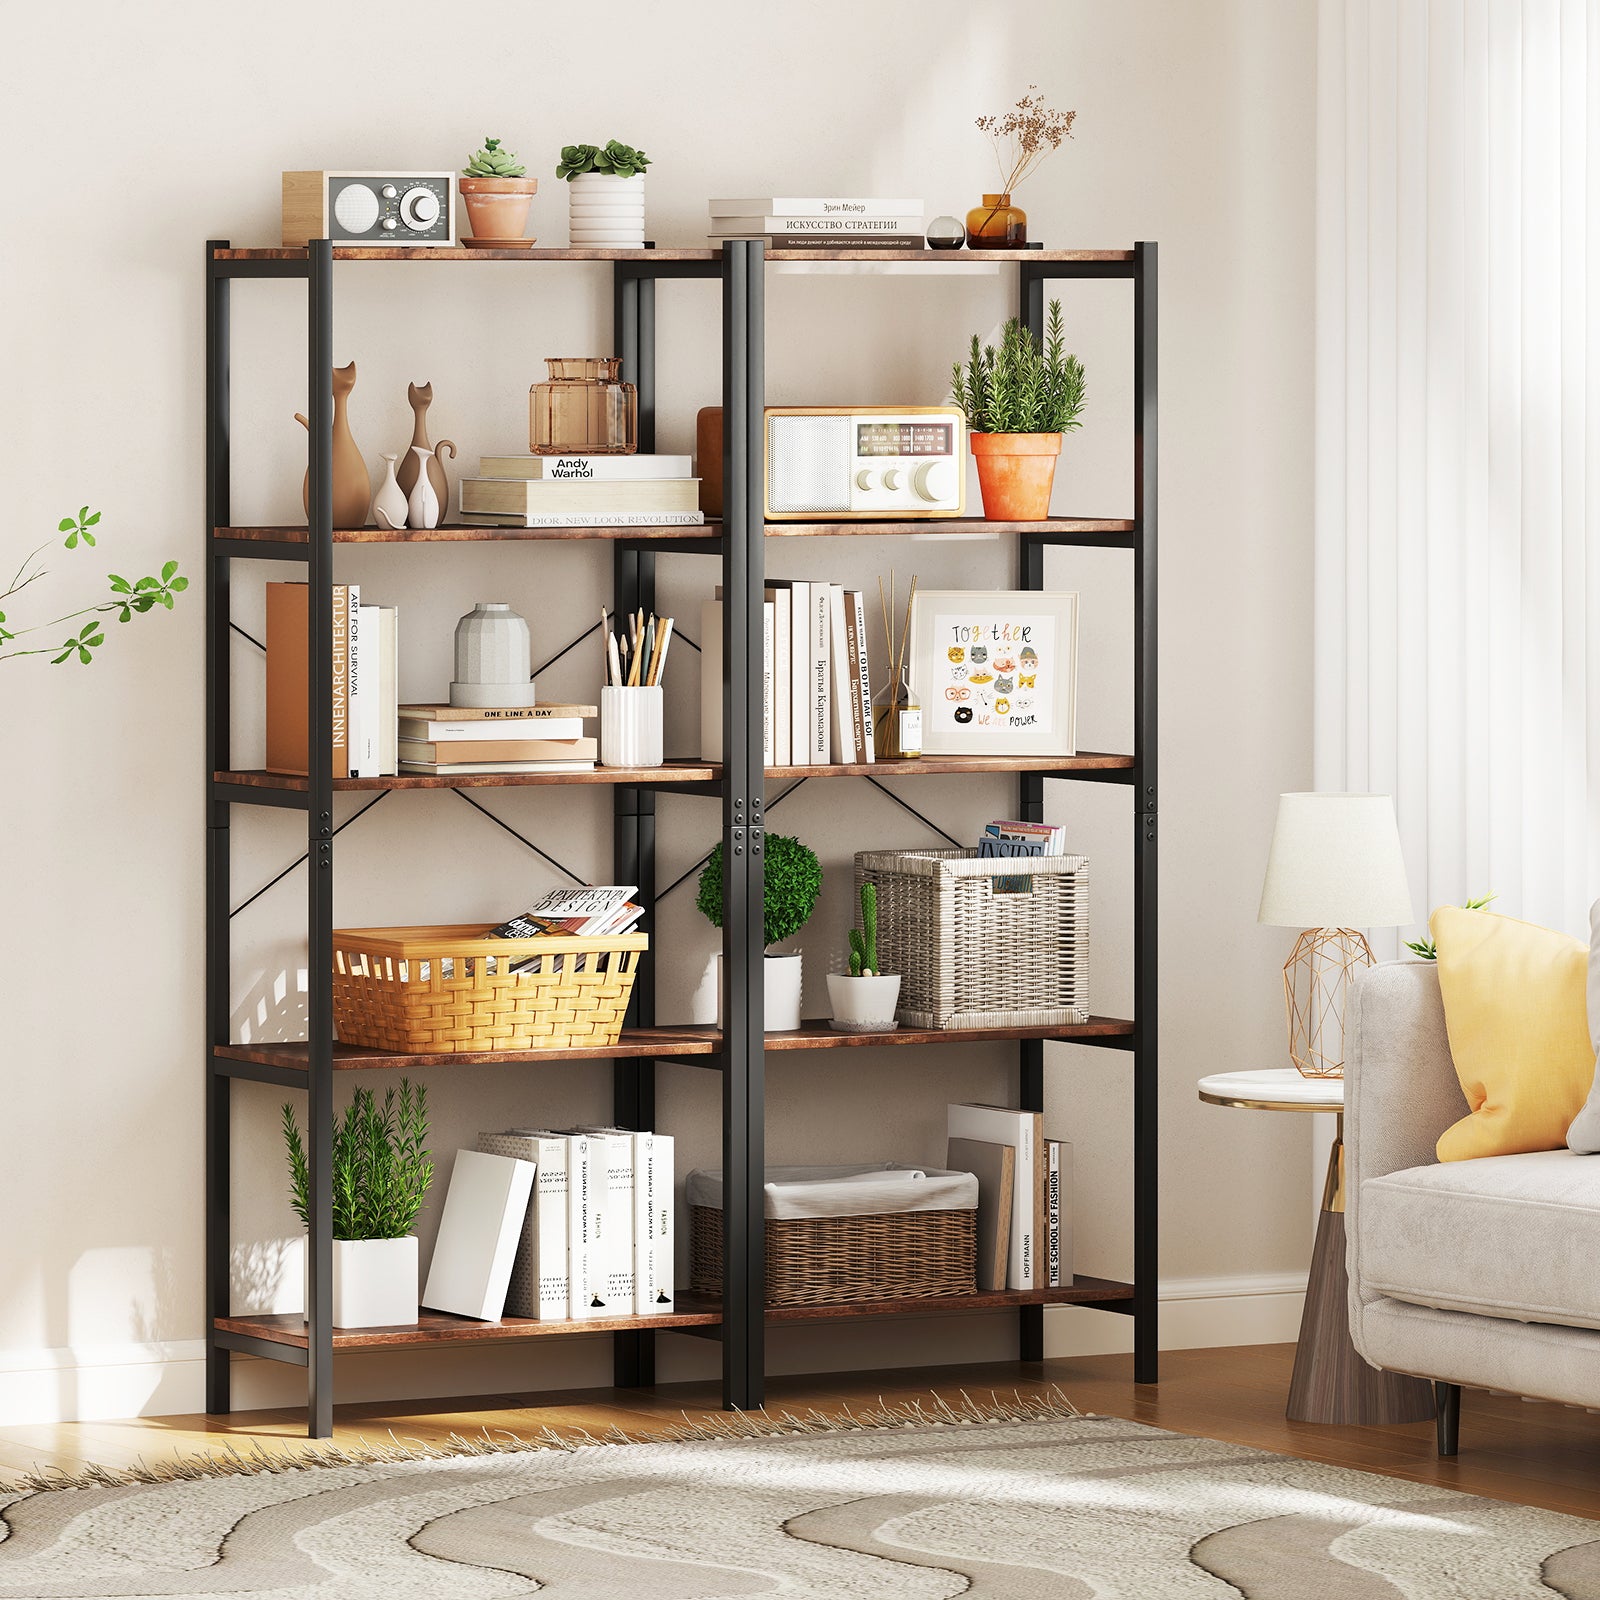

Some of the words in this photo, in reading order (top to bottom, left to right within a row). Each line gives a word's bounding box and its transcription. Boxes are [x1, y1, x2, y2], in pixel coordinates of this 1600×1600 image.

[823, 203, 840, 213] Эрин
[842, 203, 866, 213] Мейер
[786, 220, 842, 229] ИСКУССТВО
[845, 220, 897, 229] СТРАТЕГИИ
[551, 469, 593, 478] Warhol
[556, 459, 589, 470] Andy
[565, 517, 591, 525] NEW
[594, 516, 625, 524] LOOK
[628, 515, 700, 523] REVOLUTION
[333, 586, 345, 748] INNENARCHITEKTUR
[350, 646, 358, 697] SURVIVAL
[815, 660, 826, 693] Братья
[860, 651, 869, 694] ГОВОРИ
[851, 679, 859, 722] Бархатная
[863, 699, 871, 717] КАК
[815, 695, 826, 752] Карамазовы
[854, 723, 862, 751] смерть
[980, 841, 1042, 858] INSIDE
[536, 901, 614, 912] DESIGN
[1050, 1170, 1058, 1210] FASHION
[1050, 1212, 1058, 1224] OF
[1050, 1226, 1058, 1264] SCHOOL
